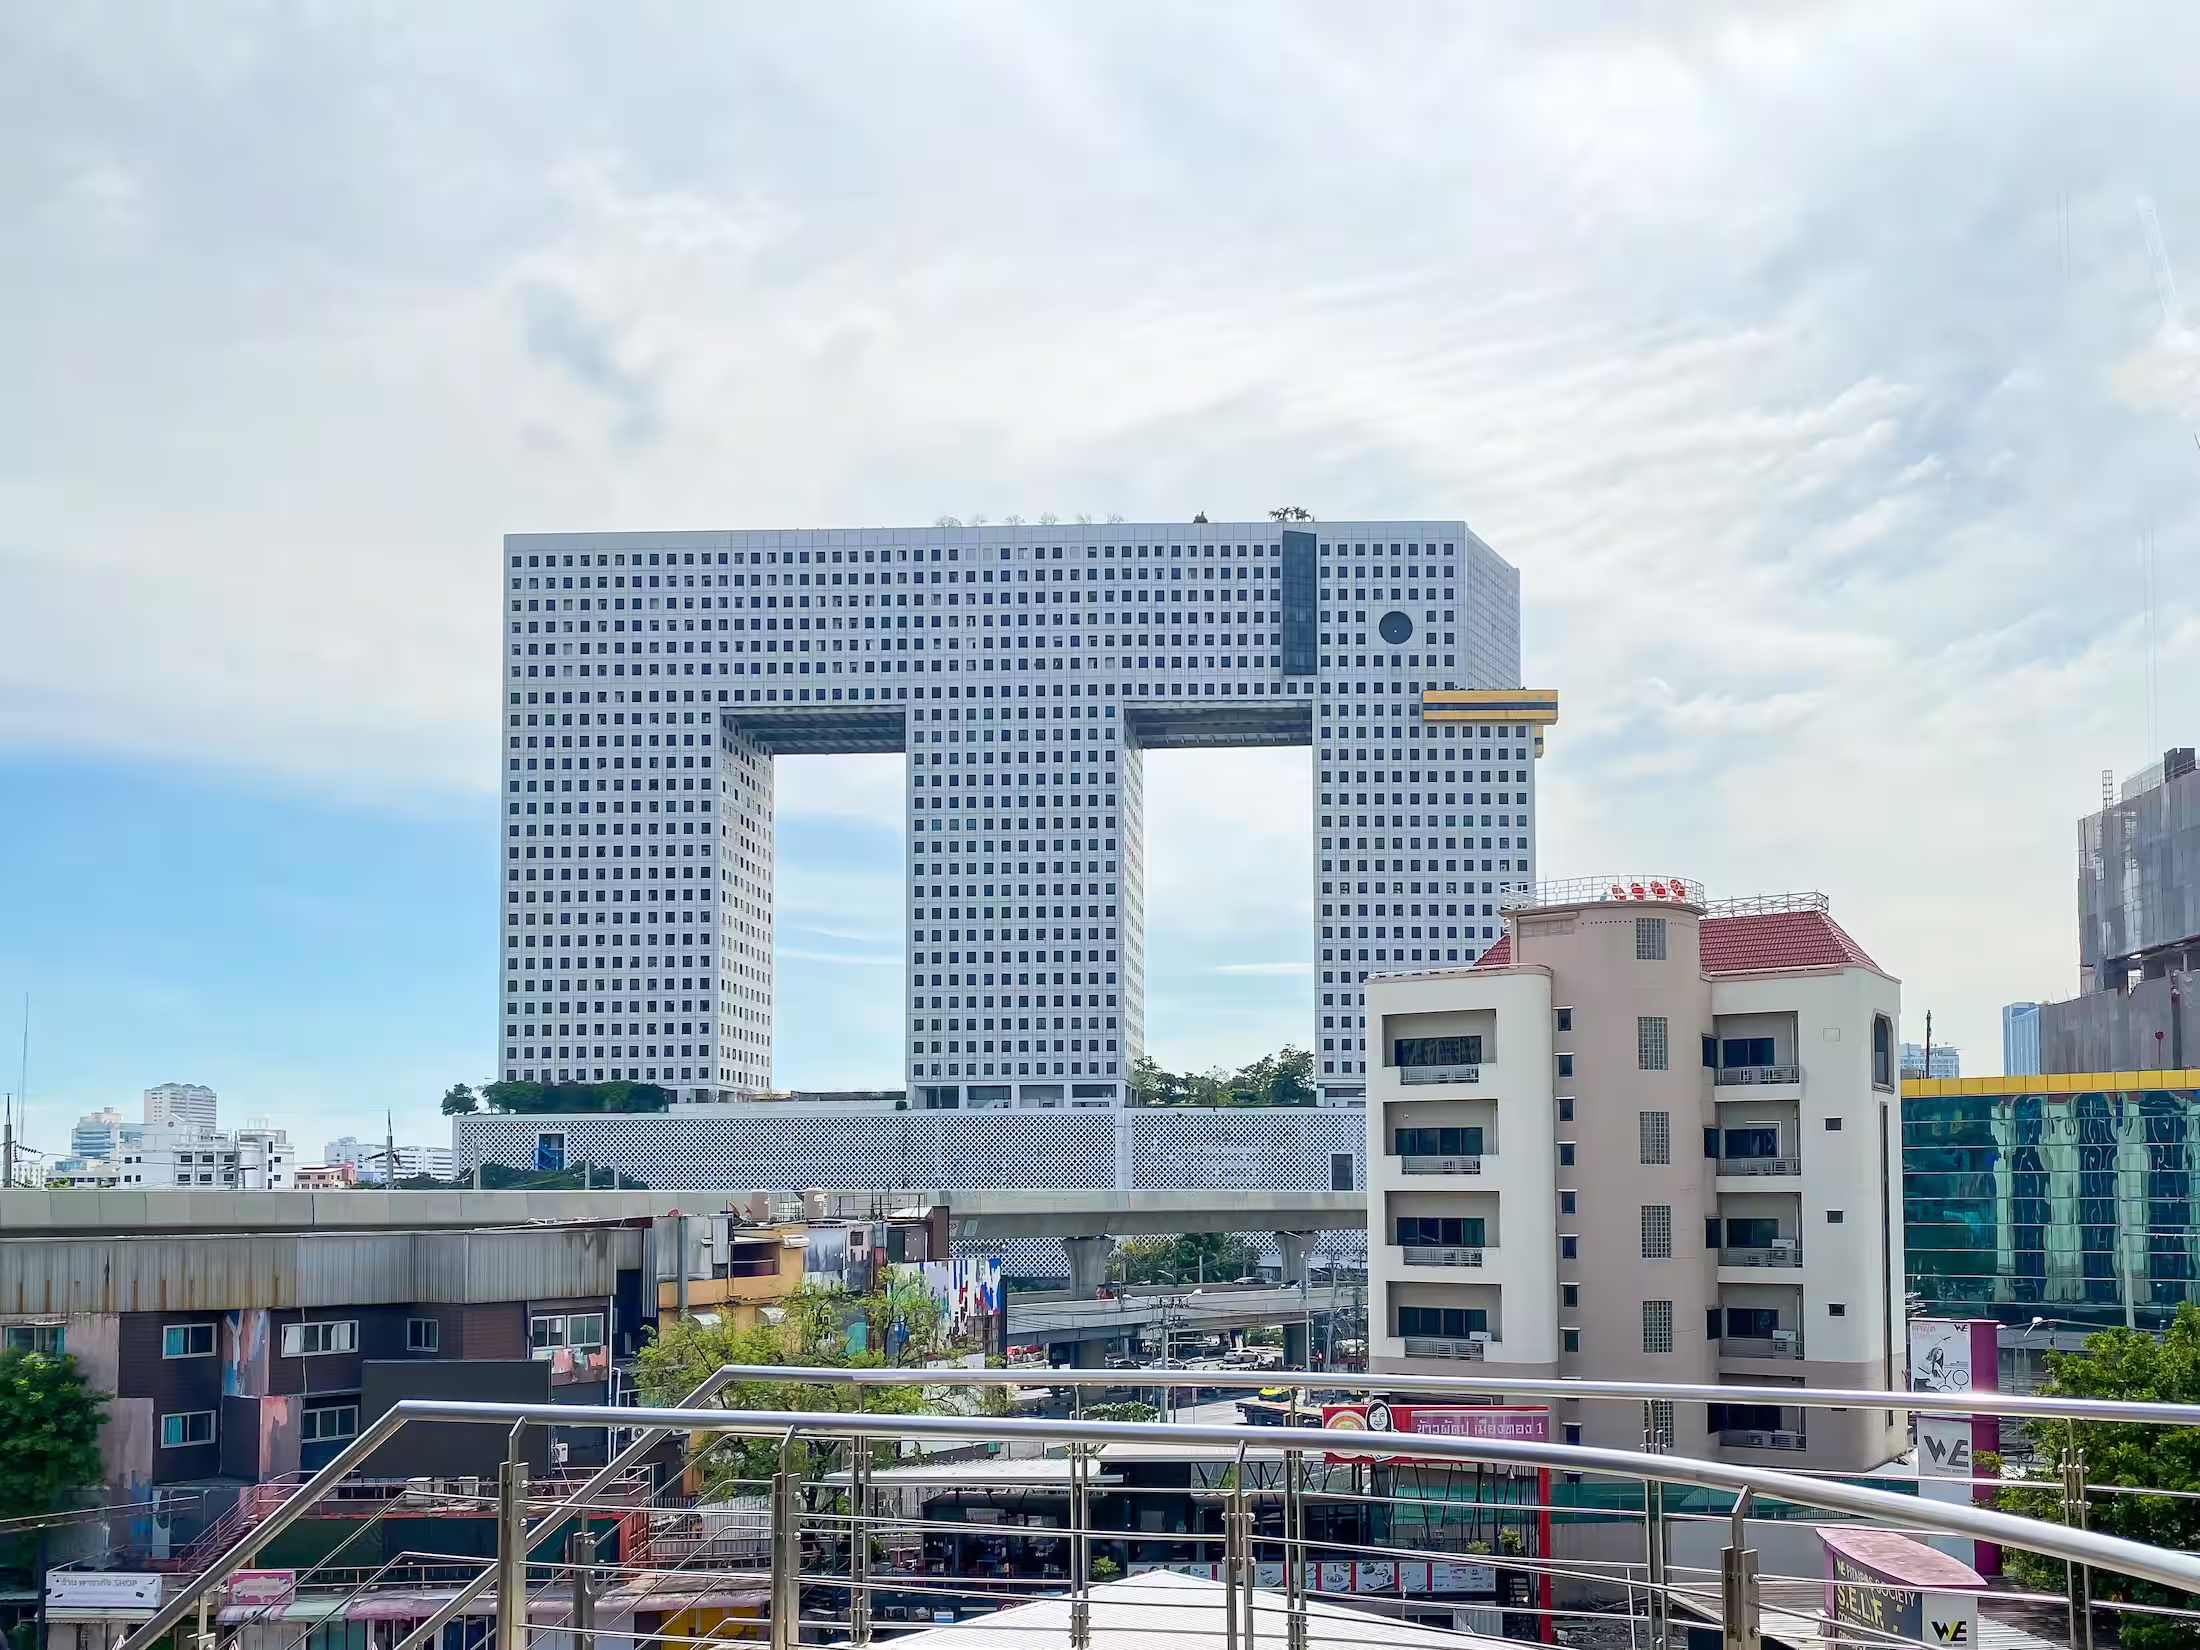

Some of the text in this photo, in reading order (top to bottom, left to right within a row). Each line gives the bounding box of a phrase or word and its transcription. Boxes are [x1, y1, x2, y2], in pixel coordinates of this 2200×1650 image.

[1953, 1324, 1968, 1333] WE
[1938, 1369, 1970, 1386] YO
[1416, 1419, 1469, 1437] ข้าวผัดป
[1537, 1422, 1544, 1435] 1
[1923, 1435, 1969, 1468] WE
[1931, 1620, 1967, 1641] WE
